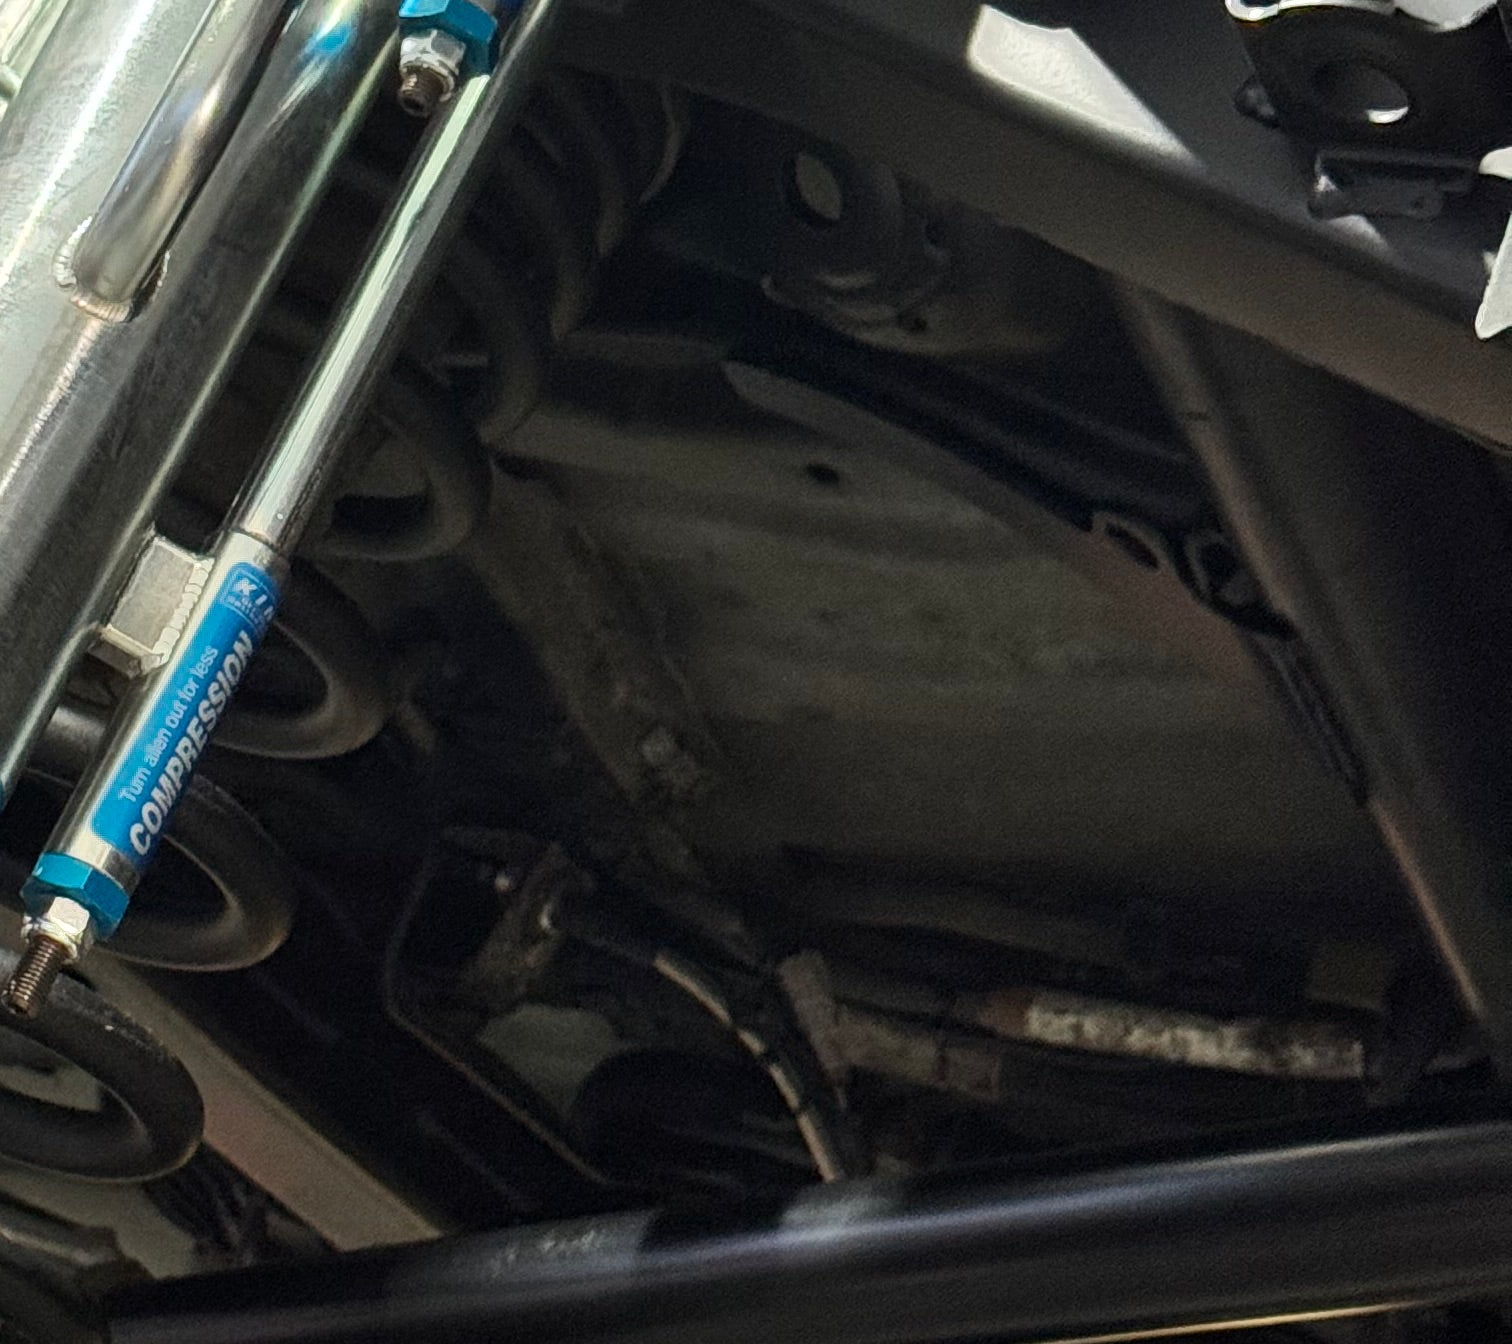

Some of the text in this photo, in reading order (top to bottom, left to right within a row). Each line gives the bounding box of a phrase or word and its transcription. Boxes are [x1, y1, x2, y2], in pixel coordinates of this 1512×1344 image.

[118, 645, 218, 802] Turn allen out for less
[129, 630, 255, 856] COMPRESSION
